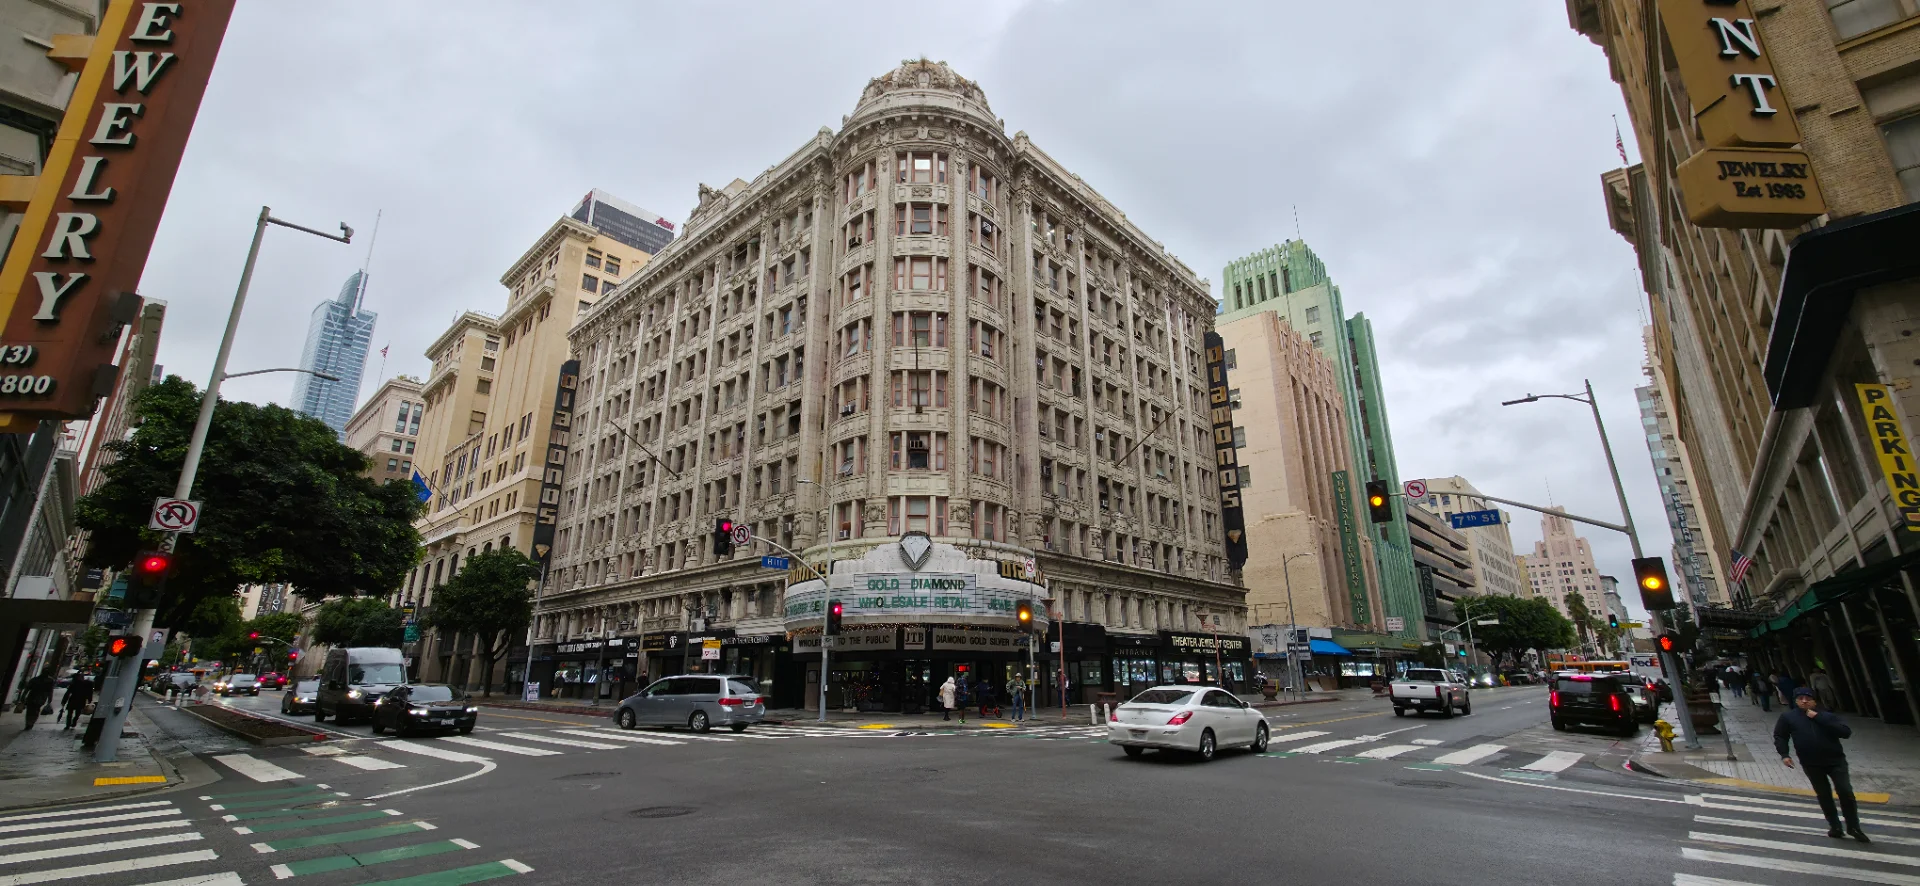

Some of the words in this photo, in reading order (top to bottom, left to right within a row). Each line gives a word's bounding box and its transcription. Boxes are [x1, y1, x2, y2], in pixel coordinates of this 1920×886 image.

[1717, 161, 1808, 180] JEWELRY
[1733, 182, 1763, 197] Est
[1765, 183, 1806, 199] 1983
[1864, 389, 1920, 506] PARKING
[1334, 473, 1351, 534] WHOLESALE
[1454, 514, 1477, 526] 7th
[1481, 513, 1497, 522] St
[1672, 493, 1692, 542] WESTERN
[767, 558, 784, 567] Hill
[867, 579, 899, 591] GOLD
[911, 578, 966, 591] DIAMOND
[859, 596, 928, 609] WHOLESALE
[934, 596, 972, 609] RETAIL
[799, 638, 822, 648] WHOLES
[837, 637, 846, 646] TO
[849, 636, 861, 645] THE
[865, 635, 890, 644] PUBLIC
[905, 632, 924, 643] JTB
[935, 634, 966, 645] DIAMOND
[969, 637, 987, 646] GOLD
[989, 638, 1010, 647] SILVER
[1171, 636, 1198, 648] THEATER
[1222, 639, 1243, 649] CENTER
[1630, 657, 1660, 667] FedE
